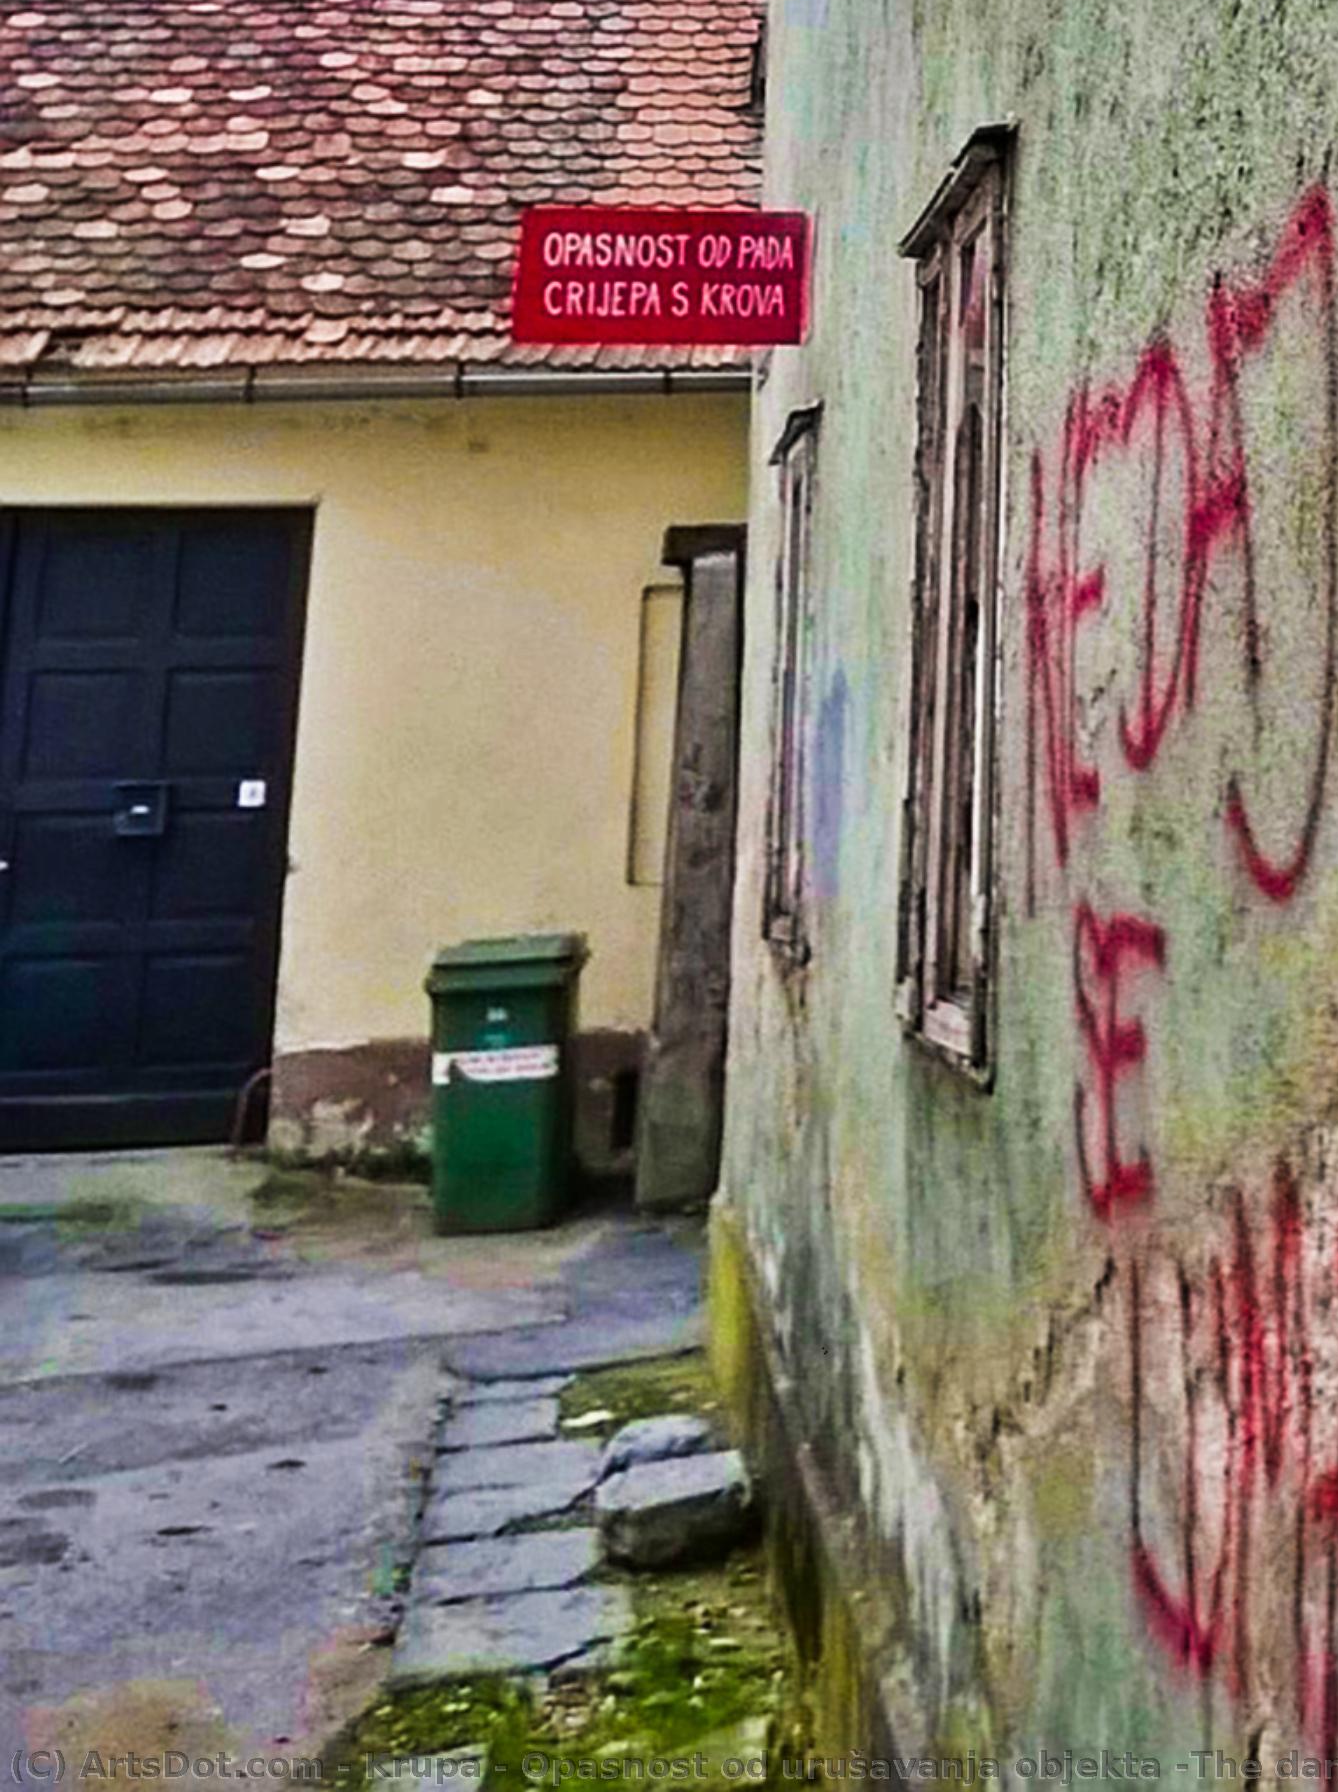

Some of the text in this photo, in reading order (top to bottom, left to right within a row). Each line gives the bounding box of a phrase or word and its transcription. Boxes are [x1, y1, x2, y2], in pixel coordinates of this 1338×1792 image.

[543, 232, 794, 270] OPASNOST OD PADA
[543, 281, 785, 317] CRIJEPA S KROVA
